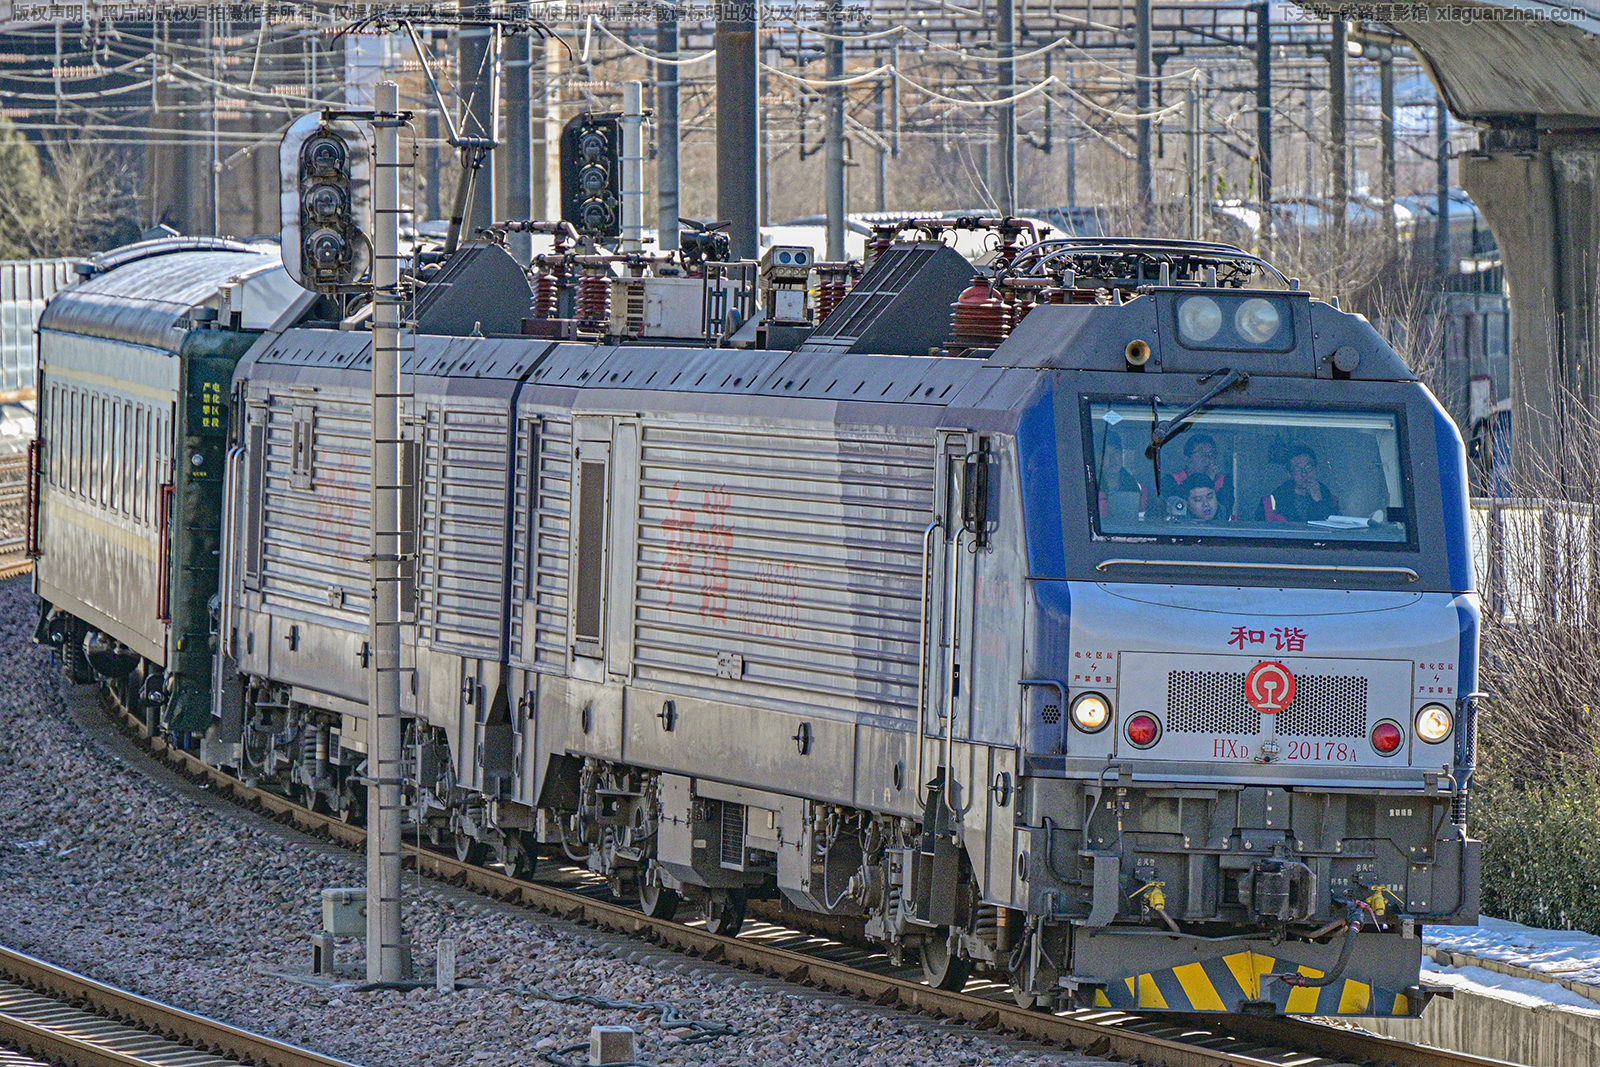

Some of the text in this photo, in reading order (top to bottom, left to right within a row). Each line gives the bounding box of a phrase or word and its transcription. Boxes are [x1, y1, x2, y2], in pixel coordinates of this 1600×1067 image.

[1227, 625, 1310, 652] 和谐
[1074, 651, 1113, 660] 电化区段
[1419, 662, 1454, 671] 电化区段
